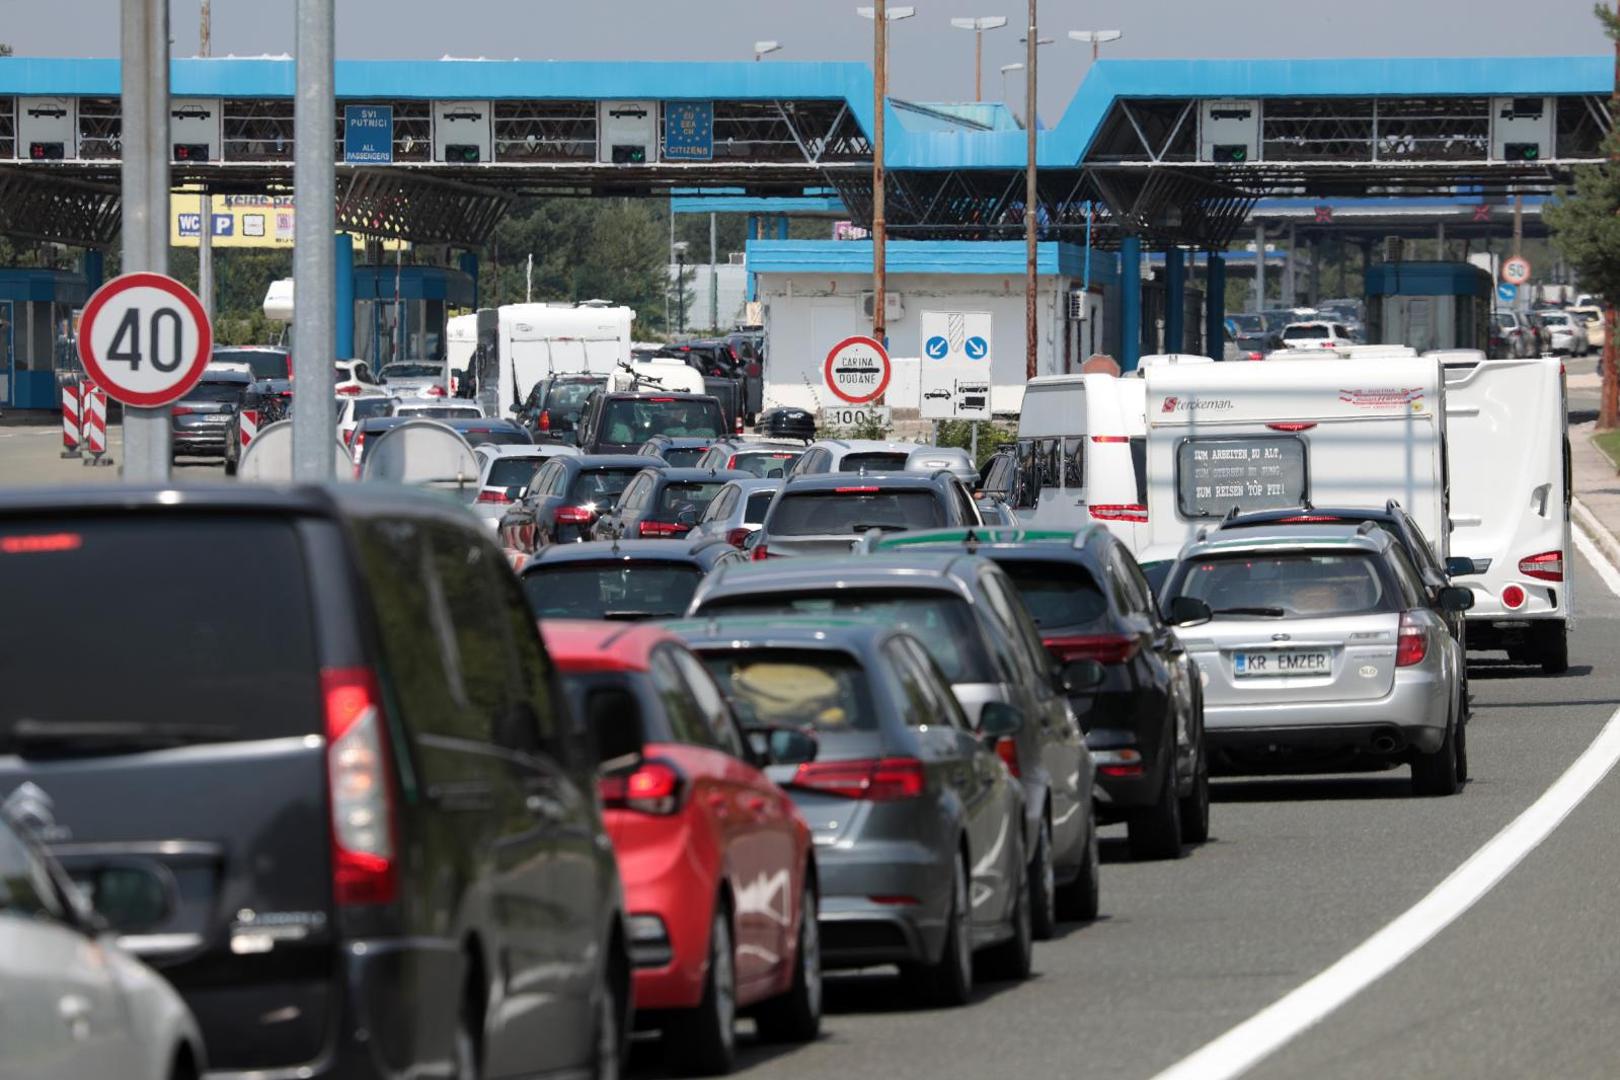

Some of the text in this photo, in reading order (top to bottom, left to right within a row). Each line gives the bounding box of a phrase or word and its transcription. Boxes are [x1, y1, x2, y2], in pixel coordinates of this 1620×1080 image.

[361, 109, 377, 118] SVI
[351, 119, 387, 127] PUTNICI
[346, 152, 390, 160] PASSENGERS
[669, 146, 708, 154] CITIZENS
[179, 215, 200, 231] WC
[215, 216, 231, 234] P
[106, 307, 183, 373] 40
[842, 357, 874, 367] CARINA
[839, 373, 877, 385] DOUANE
[835, 410, 865, 425] 100
[1212, 448, 1248, 460] ARBEITEN
[1215, 485, 1244, 498] REISEN
[1248, 653, 1326, 670] KR EMZER
